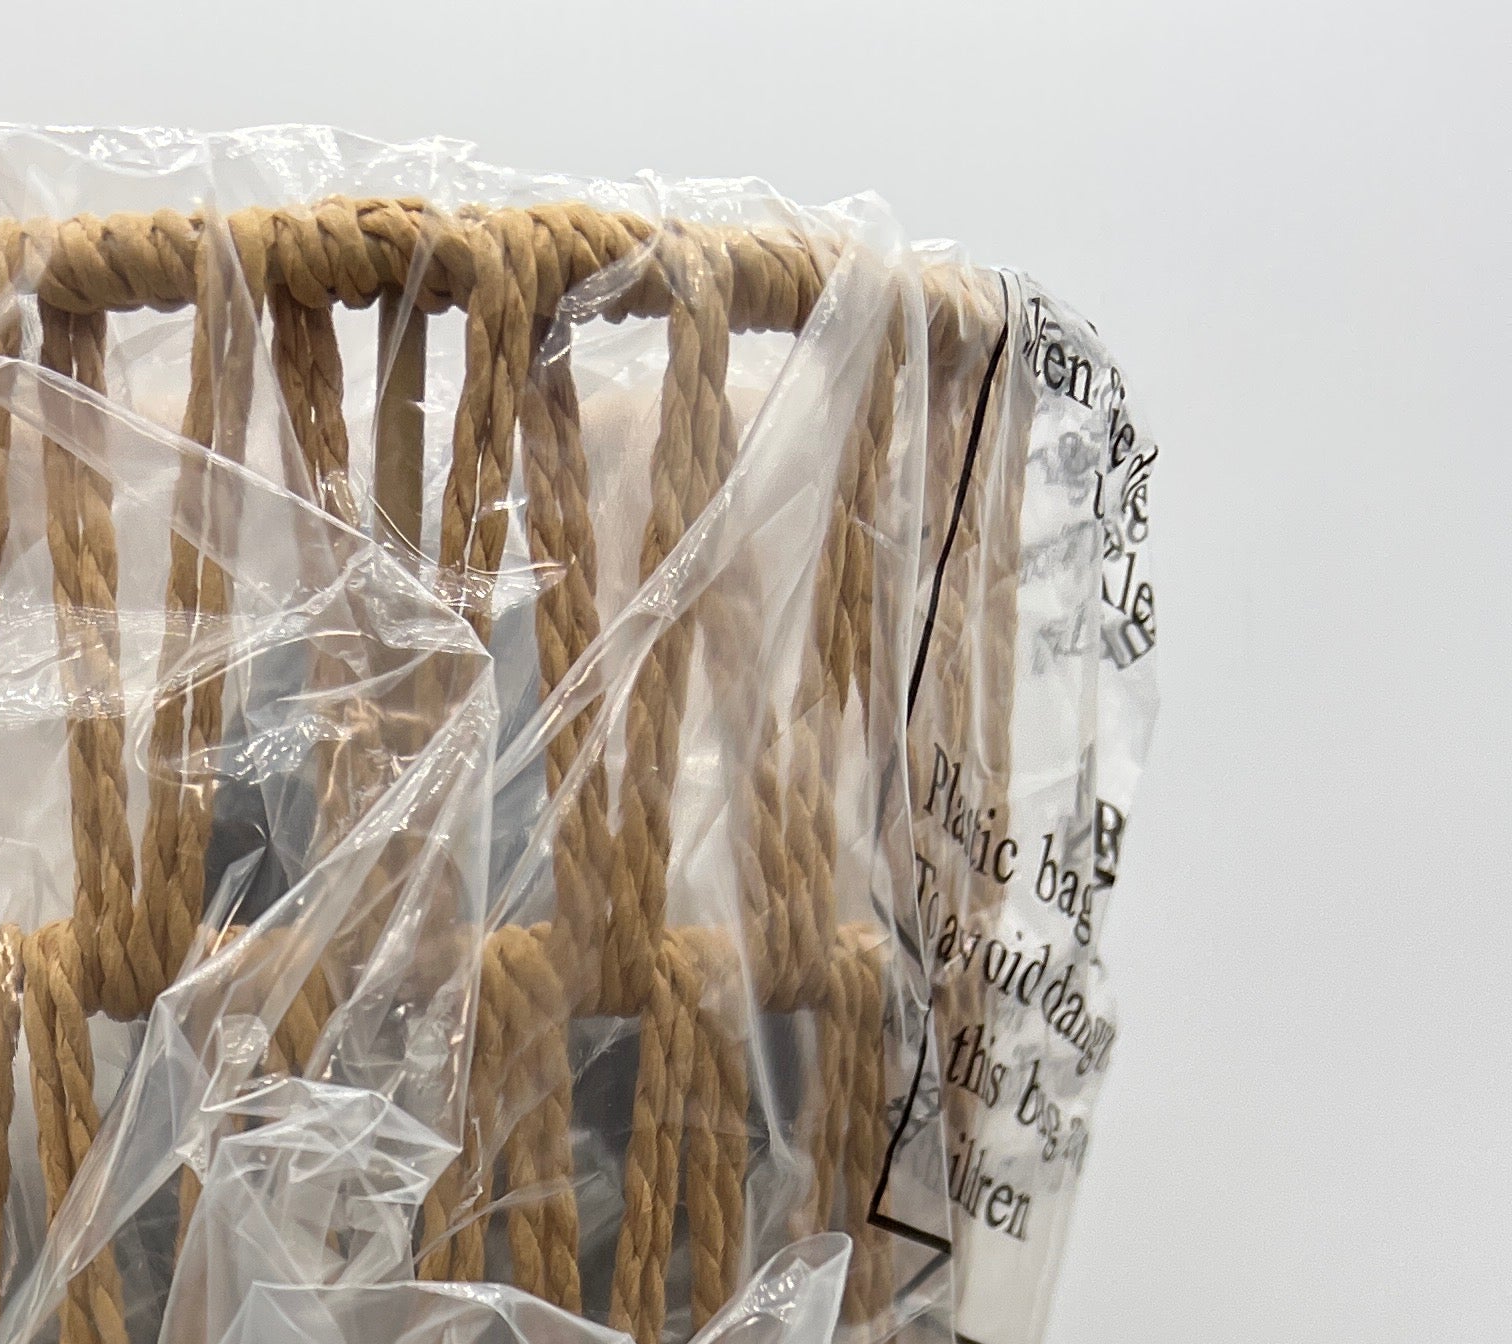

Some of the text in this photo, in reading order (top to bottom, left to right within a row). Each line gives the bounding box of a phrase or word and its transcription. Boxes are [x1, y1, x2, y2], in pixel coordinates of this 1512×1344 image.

[1035, 833, 1092, 946] bag
[937, 913, 1052, 1007] avoid
[948, 1131, 1032, 1243] ildren
